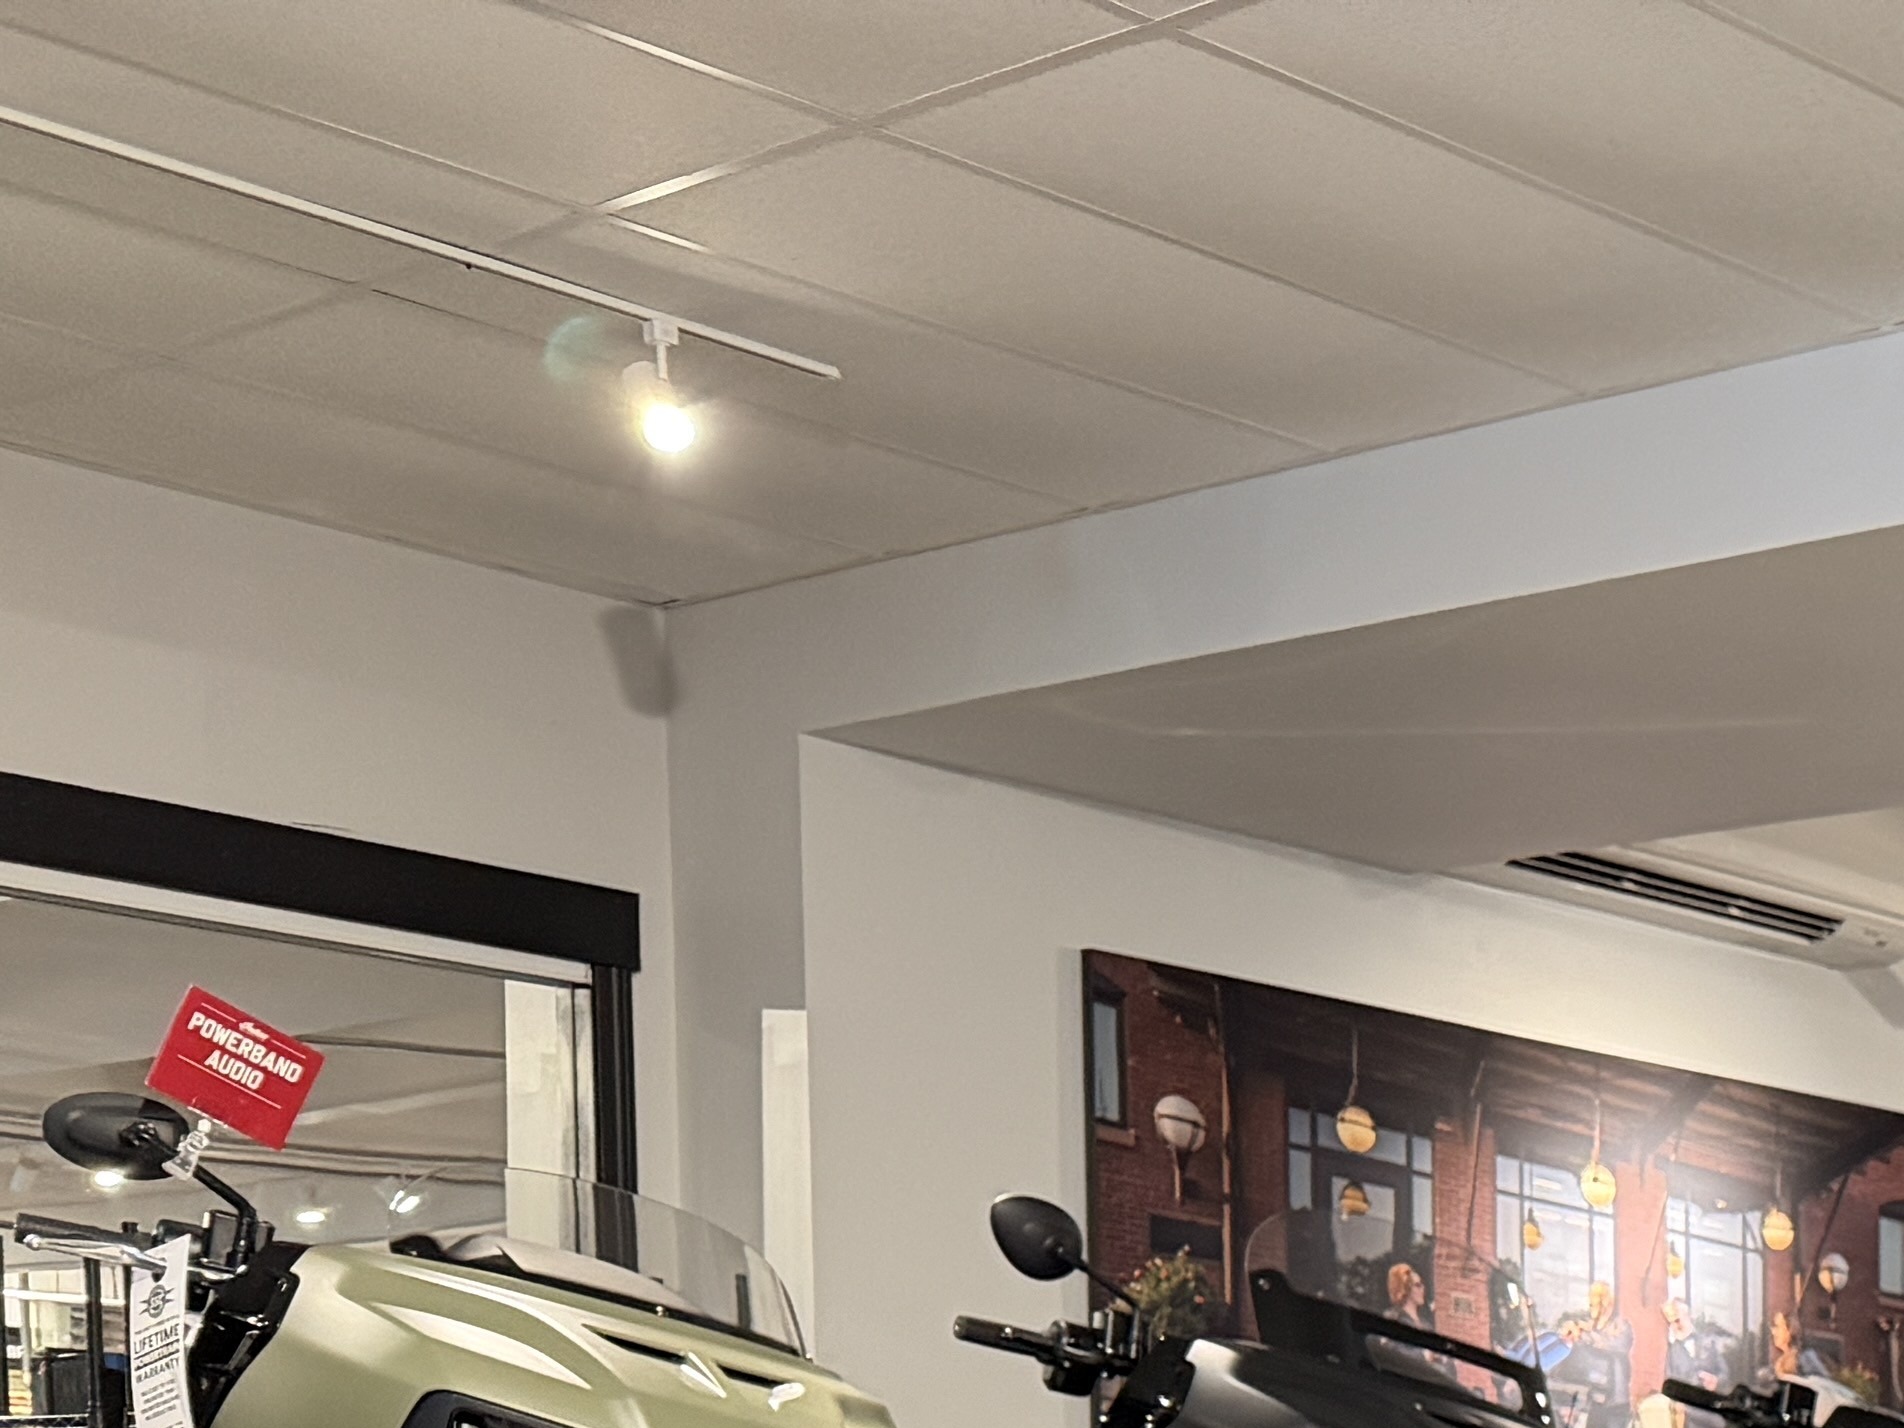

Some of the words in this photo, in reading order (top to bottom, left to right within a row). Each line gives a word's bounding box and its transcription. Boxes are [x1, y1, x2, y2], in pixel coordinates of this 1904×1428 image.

[187, 1011, 304, 1083] POWERBAND
[204, 1049, 264, 1090] AUDIO
[133, 1322, 180, 1355] LIFETIME
[136, 1356, 180, 1384] WARRANTY
